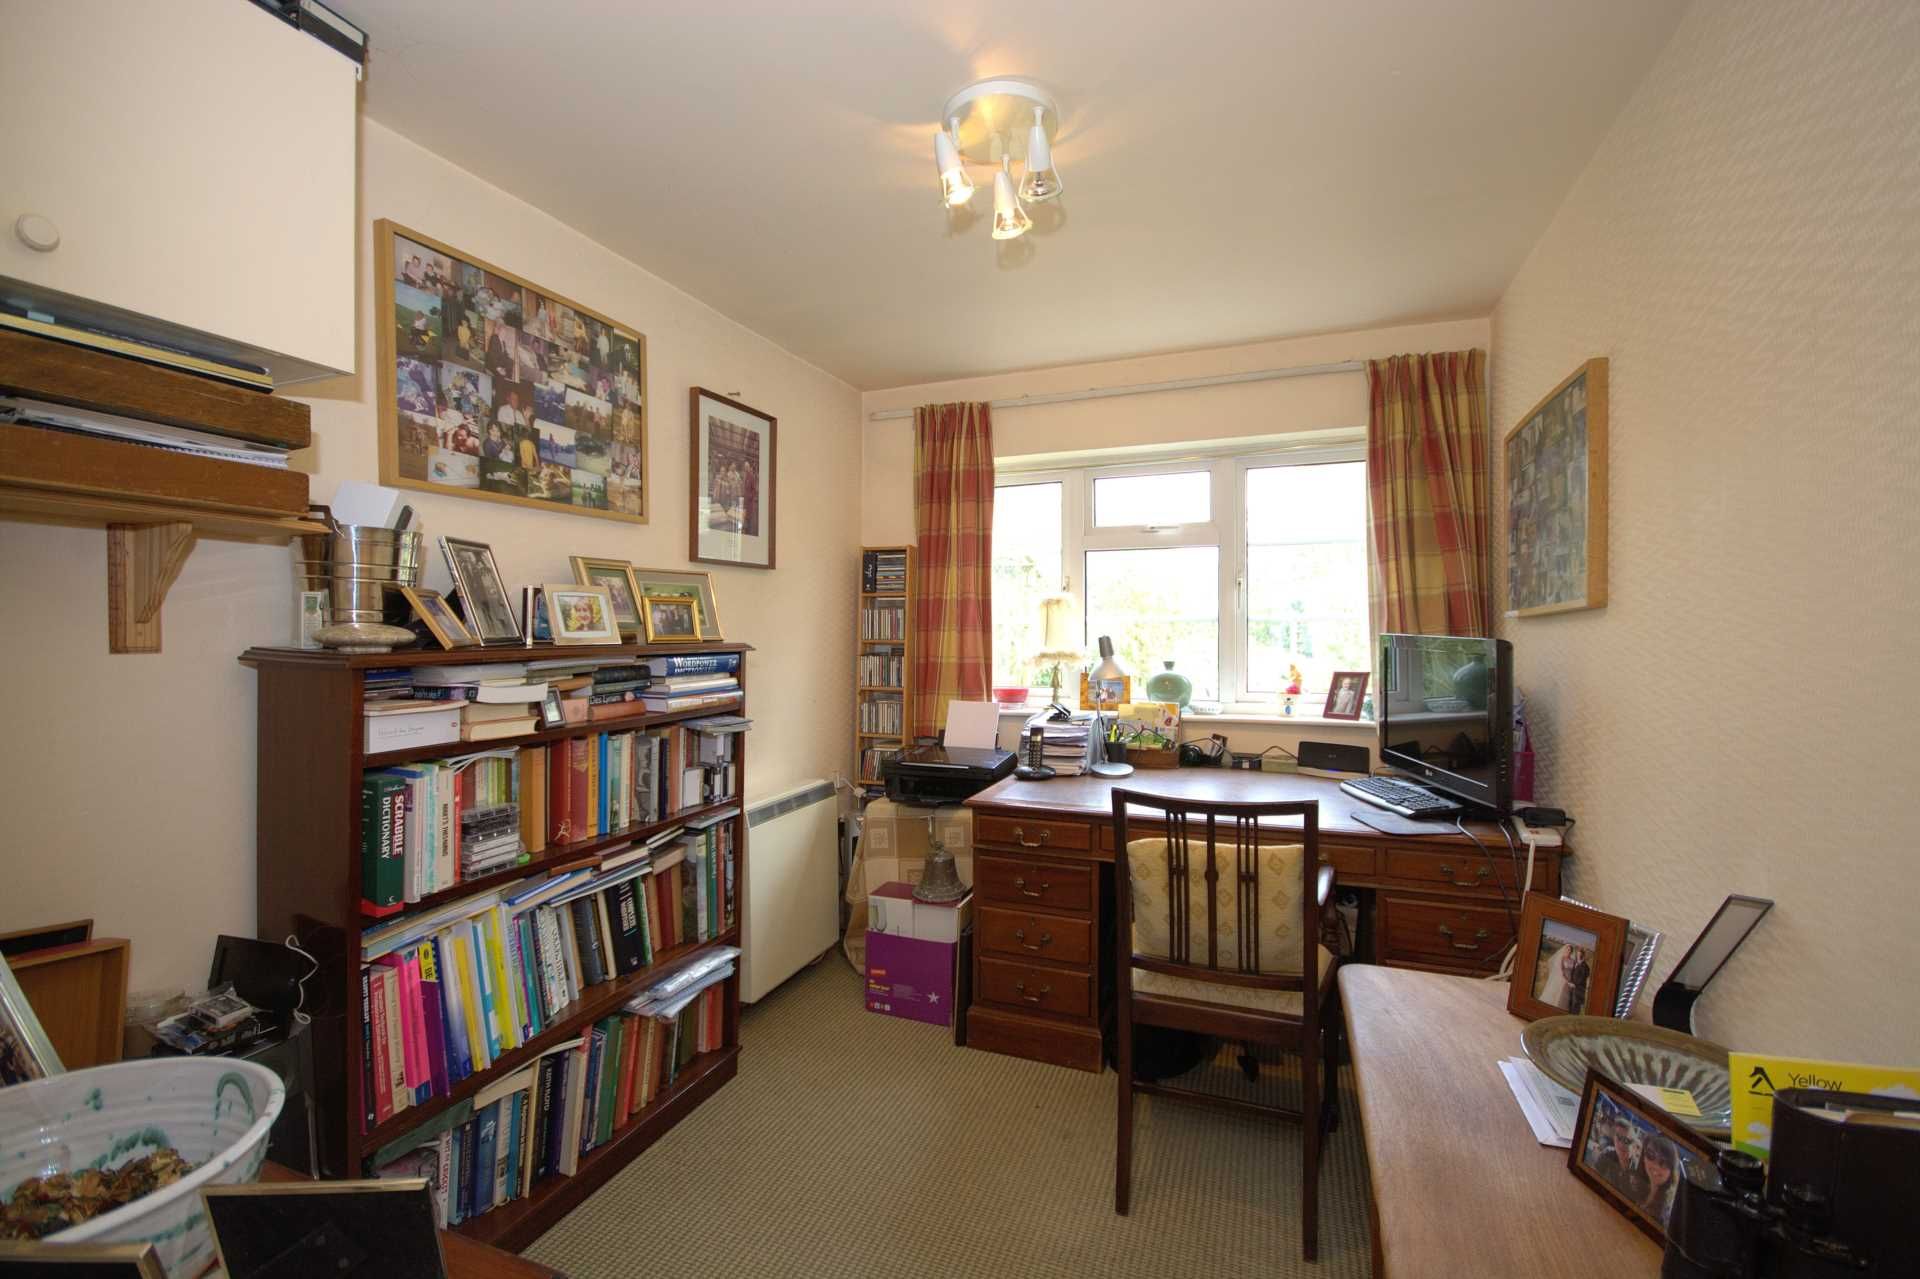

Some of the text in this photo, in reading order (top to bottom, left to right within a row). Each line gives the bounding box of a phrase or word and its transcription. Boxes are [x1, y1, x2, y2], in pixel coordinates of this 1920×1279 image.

[673, 657, 718, 668] WORDPOWER
[381, 796, 392, 859] DICTIONARY
[394, 794, 405, 857] SCRABBLE
[1788, 1071, 1842, 1092] Yellow
